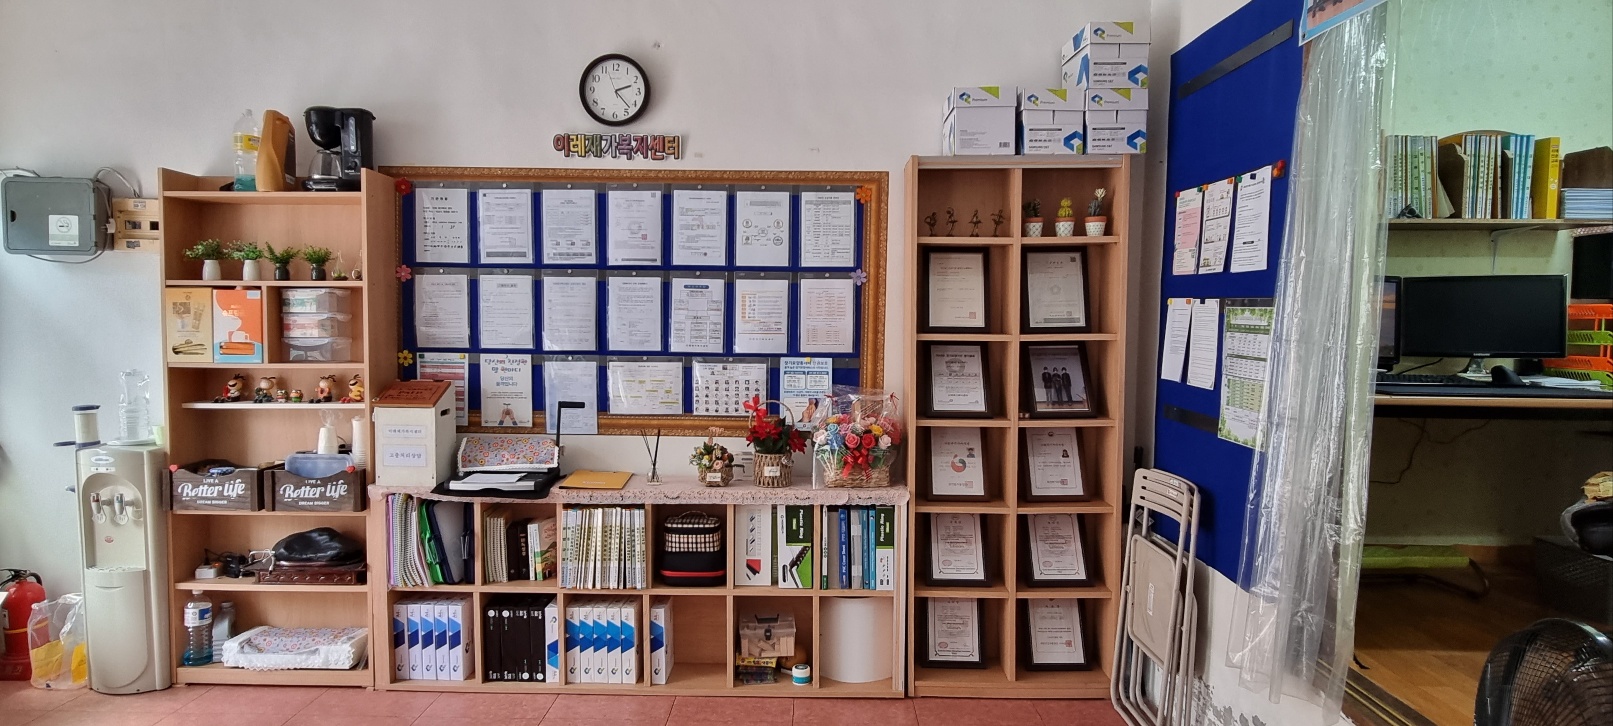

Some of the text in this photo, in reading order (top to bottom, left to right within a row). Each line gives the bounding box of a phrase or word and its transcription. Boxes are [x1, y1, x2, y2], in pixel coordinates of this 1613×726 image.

[601, 66, 608, 74] 11
[612, 63, 620, 72] 12
[626, 67, 629, 75] 1
[591, 74, 601, 83] 10
[633, 75, 639, 84] 2
[589, 86, 595, 94] 9
[635, 88, 641, 96] 3
[592, 98, 599, 107] 8
[632, 100, 637, 108] 4
[600, 107, 606, 116] 7
[612, 111, 618, 119] 6
[623, 108, 629, 117] 5
[553, 133, 680, 160] 이레재가복지센터
